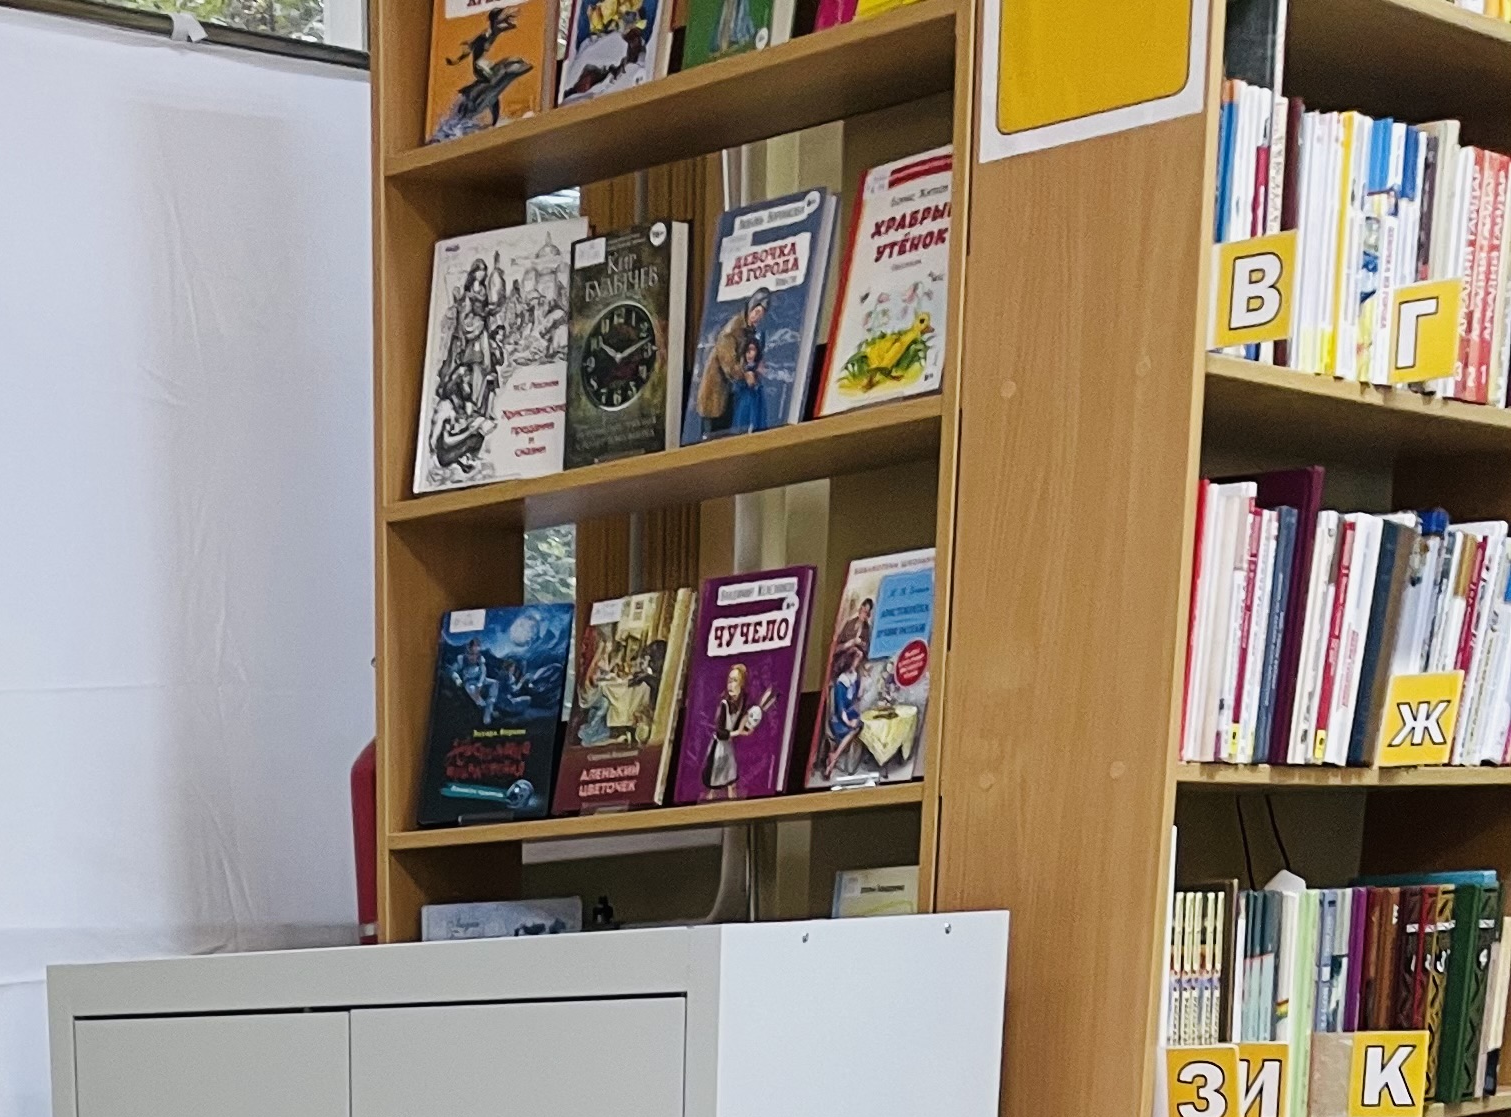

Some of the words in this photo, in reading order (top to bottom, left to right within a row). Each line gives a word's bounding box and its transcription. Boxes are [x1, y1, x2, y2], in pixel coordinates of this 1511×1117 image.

[732, 242, 797, 271] ДЕВОЧКА
[874, 227, 949, 263] УТЁНОК
[725, 268, 743, 287] ИЗ
[746, 257, 799, 282] ГОРОДА
[1229, 252, 1282, 330] В
[1395, 296, 1439, 370] Г
[714, 618, 789, 648] ЧУЧЕЛО
[1388, 700, 1451, 747] Ж
[1362, 1044, 1417, 1107] К
